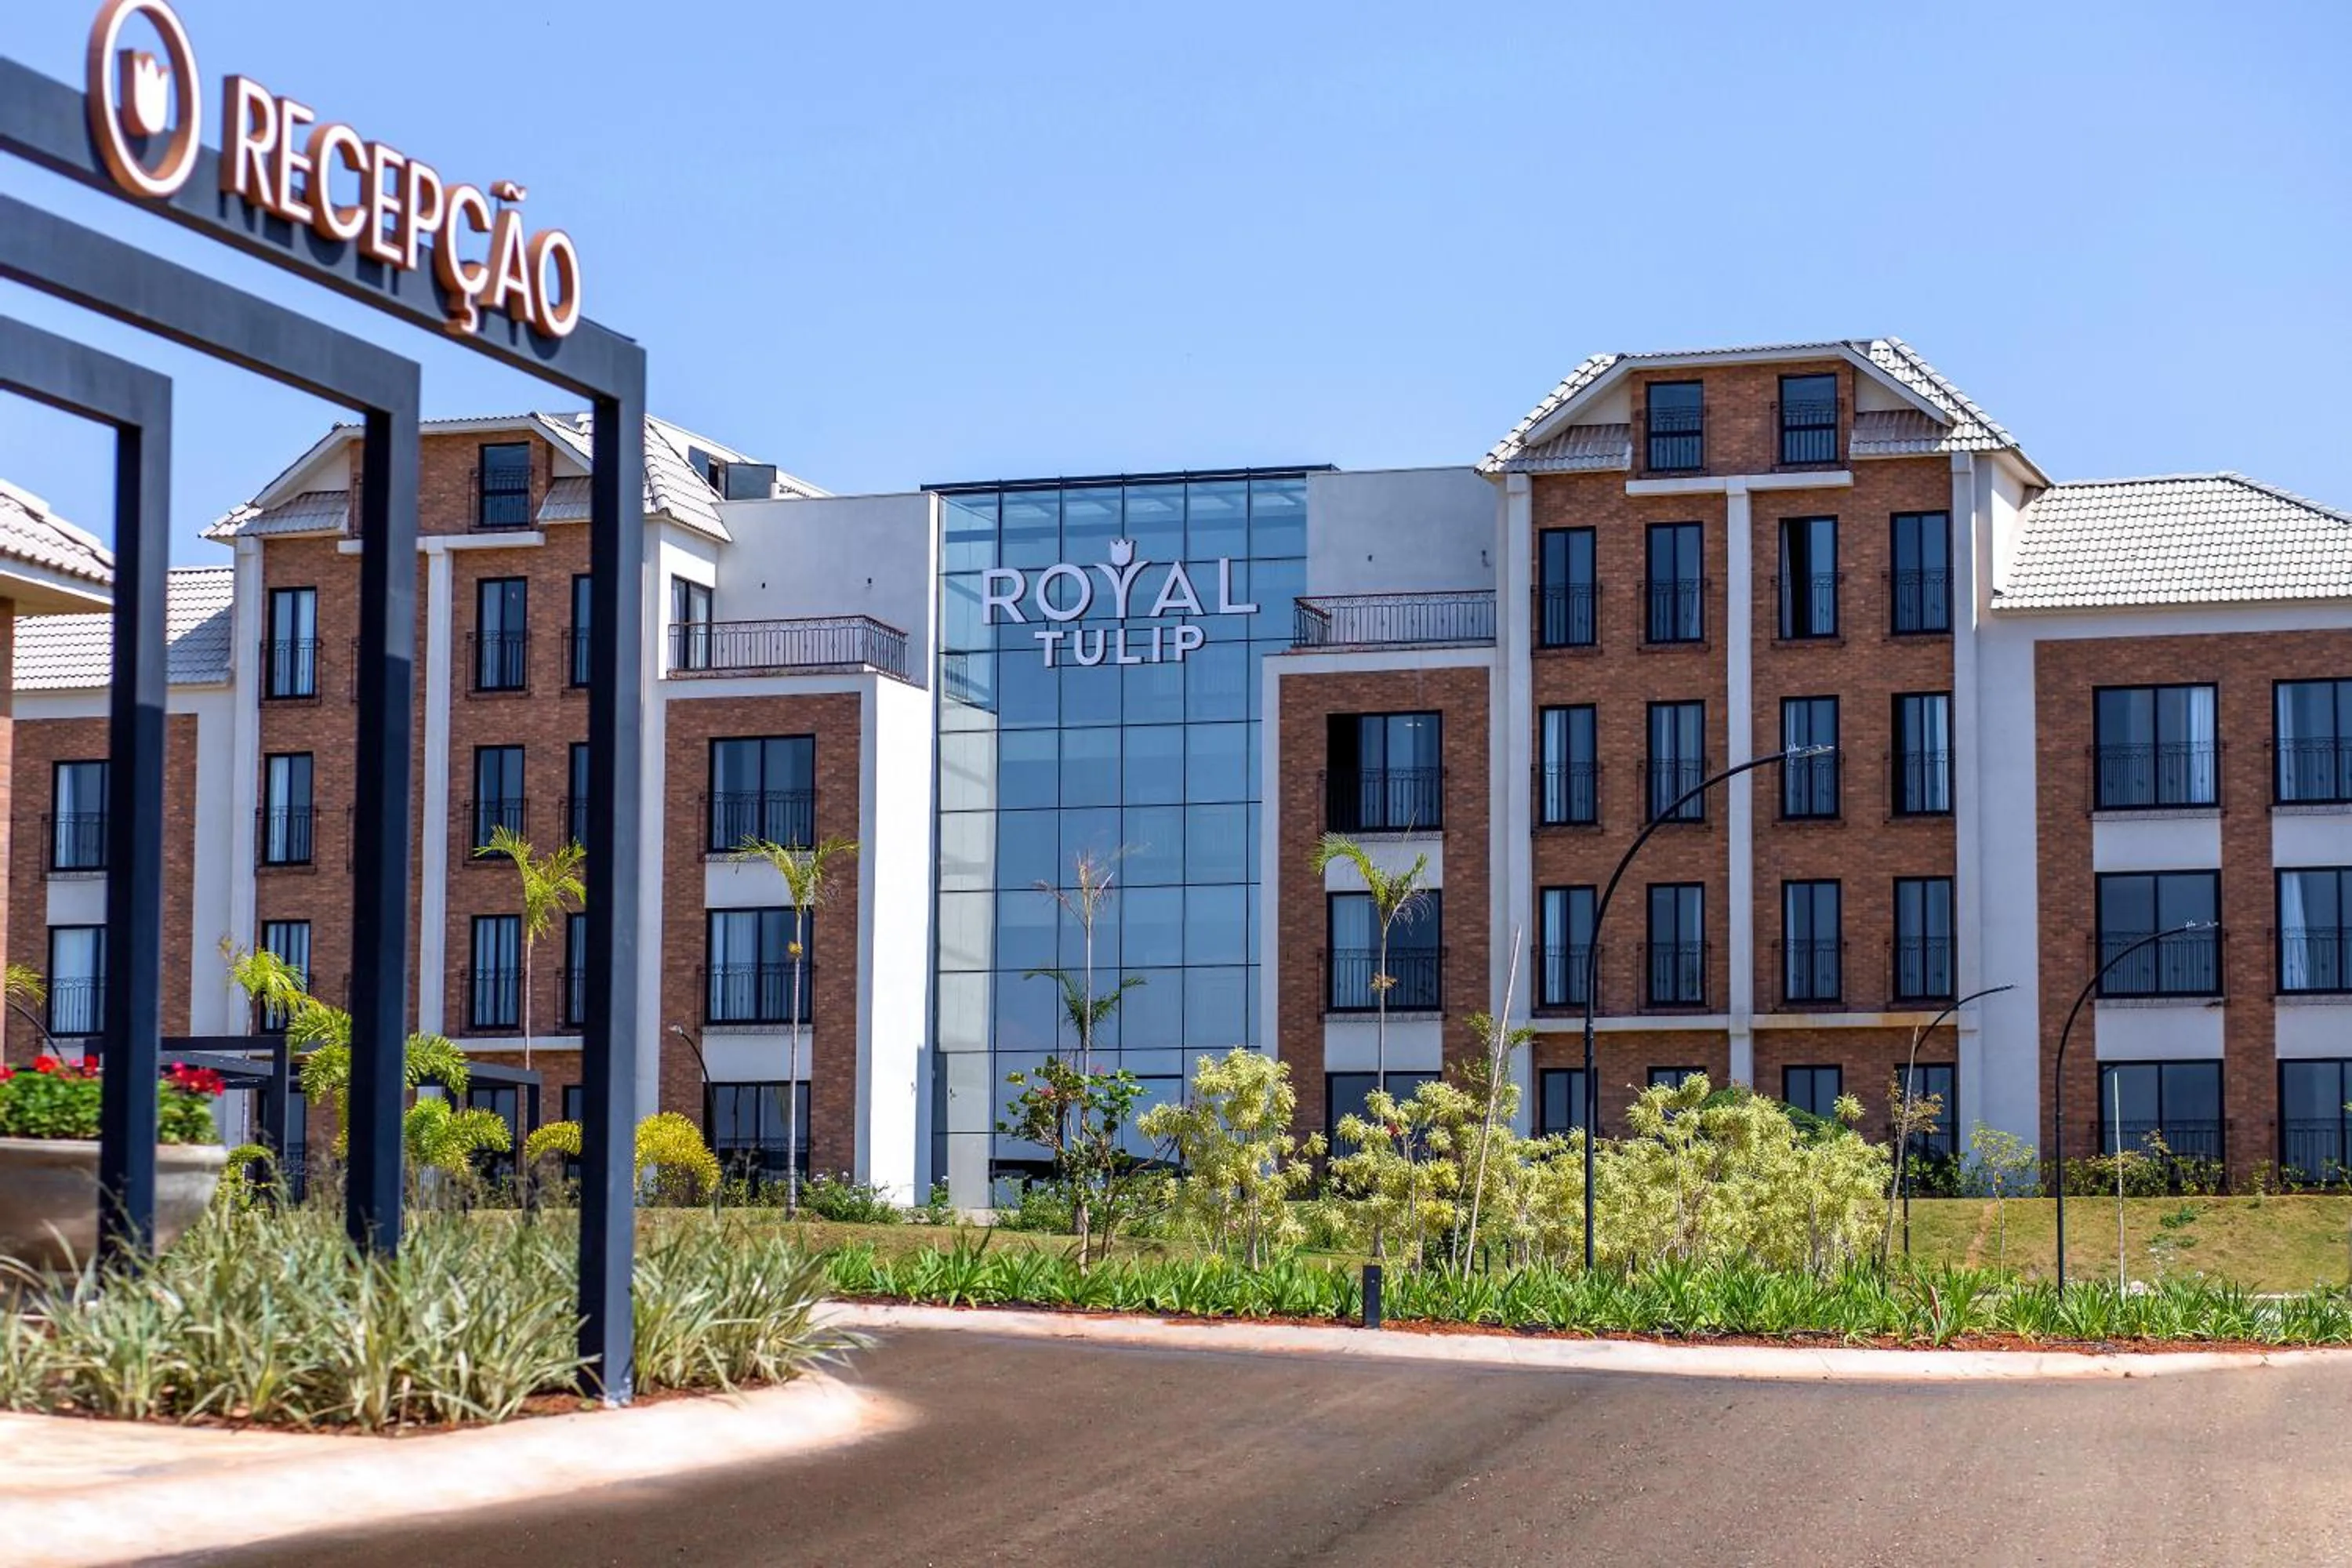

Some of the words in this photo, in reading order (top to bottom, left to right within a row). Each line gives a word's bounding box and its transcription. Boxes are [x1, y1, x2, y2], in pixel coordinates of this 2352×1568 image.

[223, 74, 581, 338] RECEPÇÃO
[982, 556, 1260, 625] ROYAL
[1034, 624, 1206, 668] TULIP
